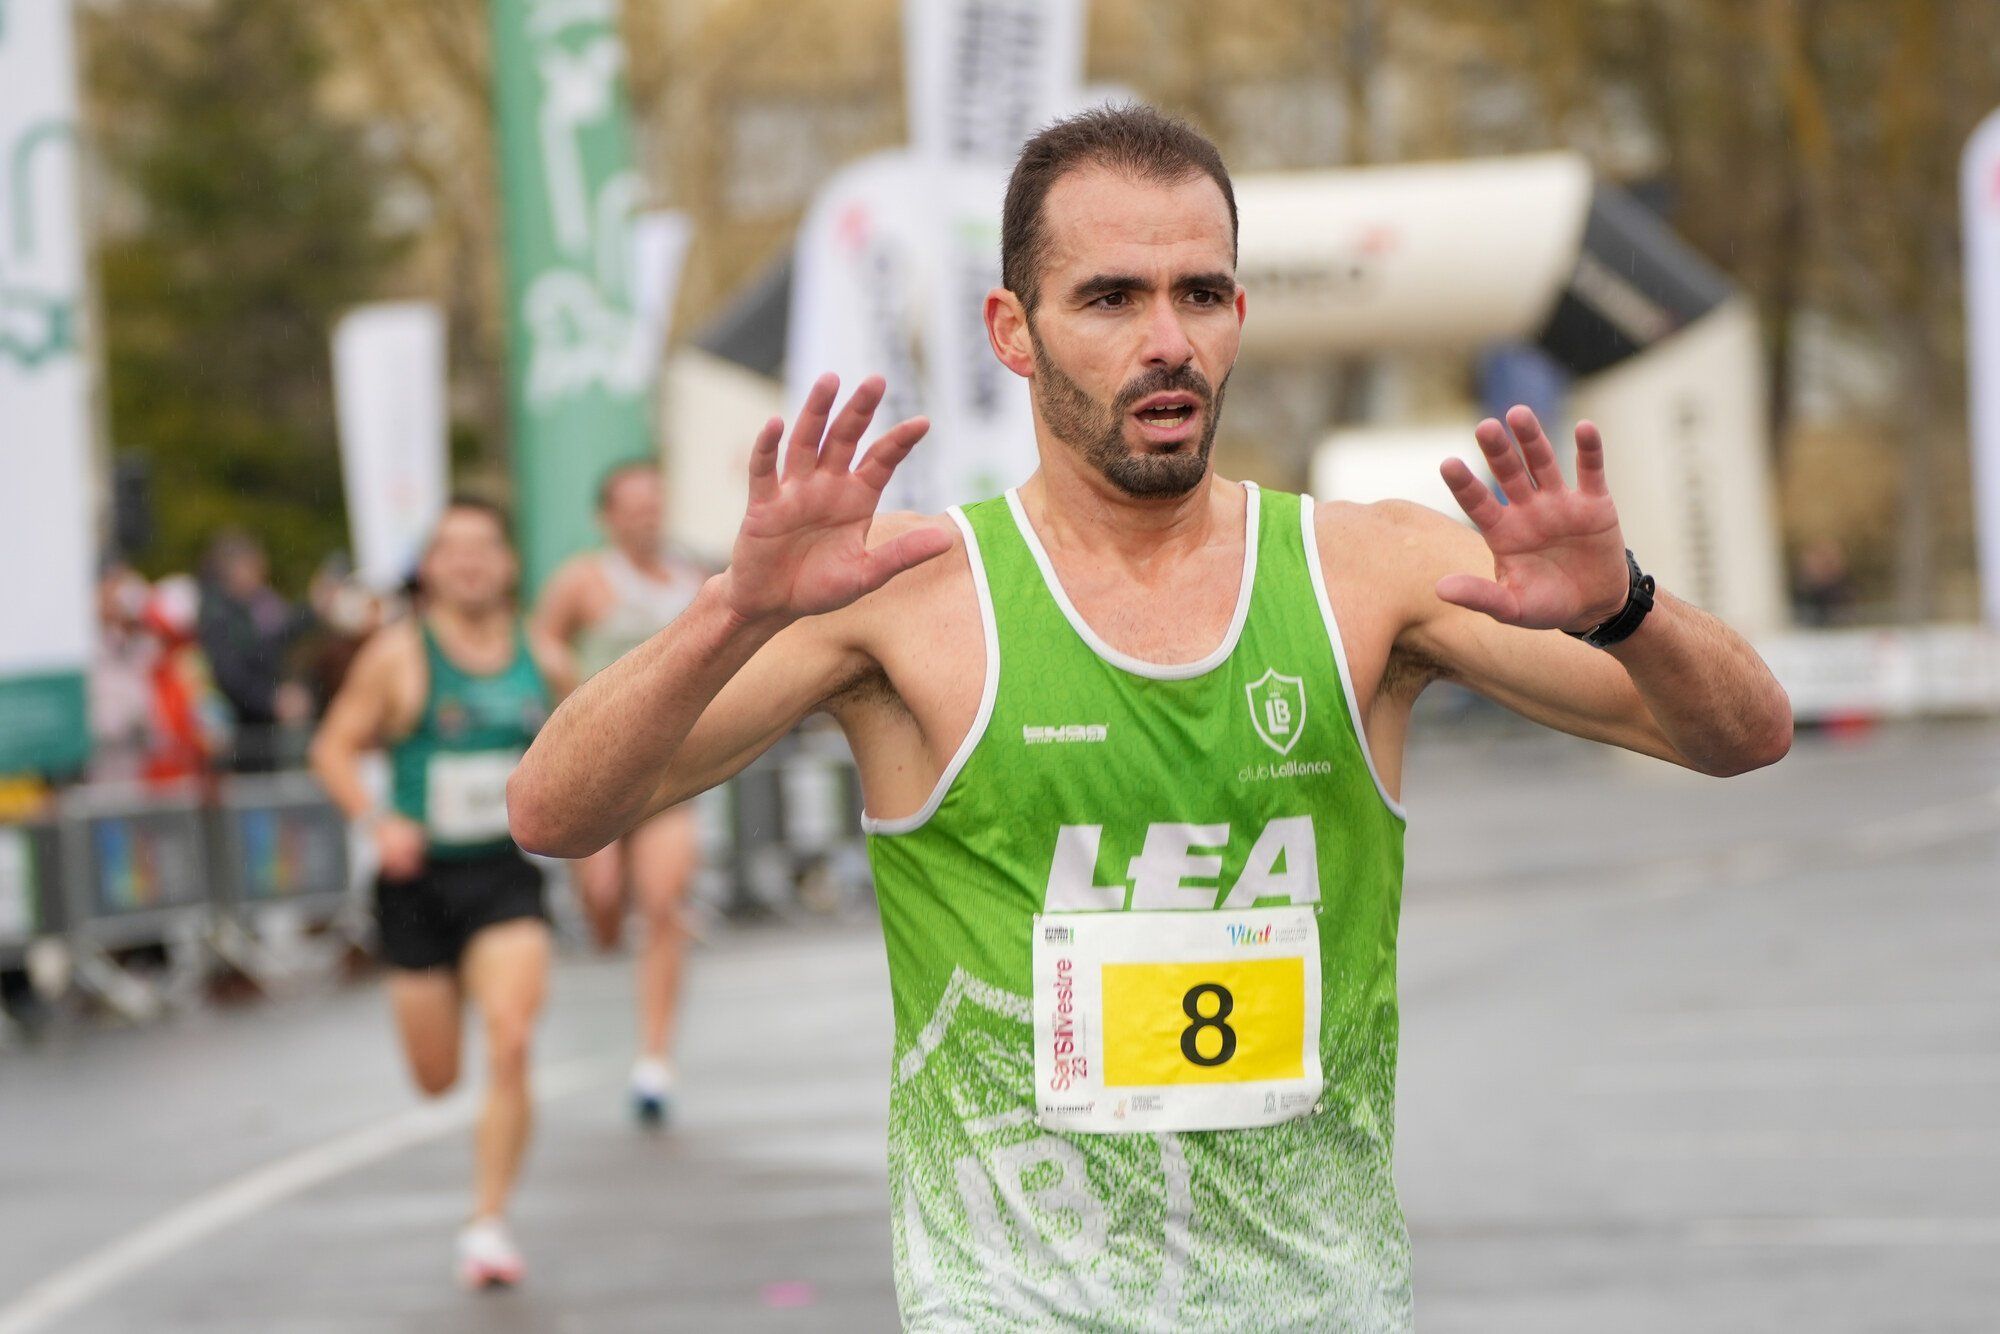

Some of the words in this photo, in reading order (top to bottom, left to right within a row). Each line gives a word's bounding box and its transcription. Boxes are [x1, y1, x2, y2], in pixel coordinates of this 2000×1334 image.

[1265, 698, 1291, 735] LB
[1238, 764, 1270, 784] club
[1271, 760, 1331, 779] LaBlanca
[1043, 814, 1321, 911] LEA
[1226, 922, 1272, 946] Vital
[1180, 983, 1237, 1067] 8
[1072, 1055, 1088, 1080] 23
